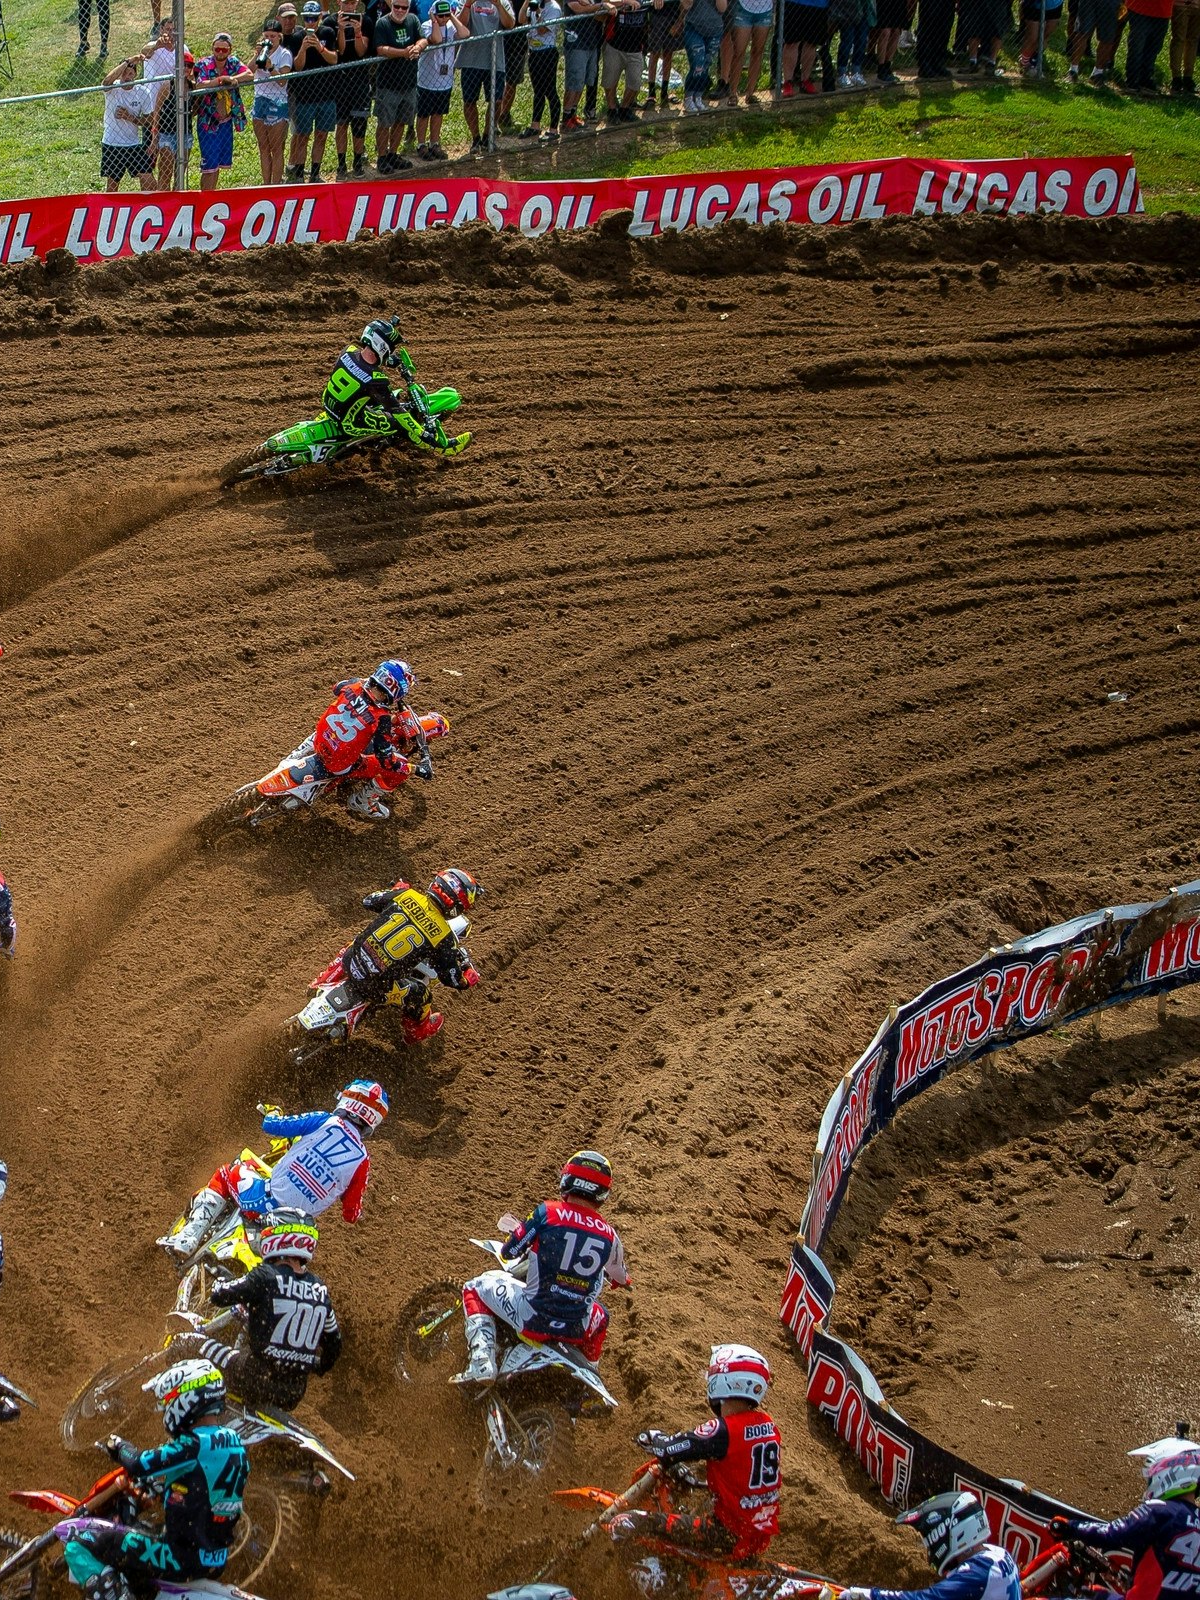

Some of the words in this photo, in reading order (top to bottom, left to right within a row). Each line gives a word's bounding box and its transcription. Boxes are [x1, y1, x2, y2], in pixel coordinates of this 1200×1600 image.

[627, 179, 798, 237] LUCAS
[807, 171, 888, 225] OIL
[912, 169, 1073, 217] LUCAS
[1082, 167, 1145, 217] OI
[64, 202, 231, 258] LUCAS
[239, 197, 320, 248] OIL
[327, 367, 361, 402] 9
[404, 415, 420, 432] FOX
[372, 912, 425, 961] 16
[401, 896, 442, 939] OSBORNE
[312, 1124, 366, 1168] 17
[559, 1231, 605, 1277] 15
[276, 1274, 328, 1303] HOEFT
[270, 1298, 327, 1350] 700
[748, 1440, 780, 1489] 19
[121, 1531, 182, 1572] FXR
